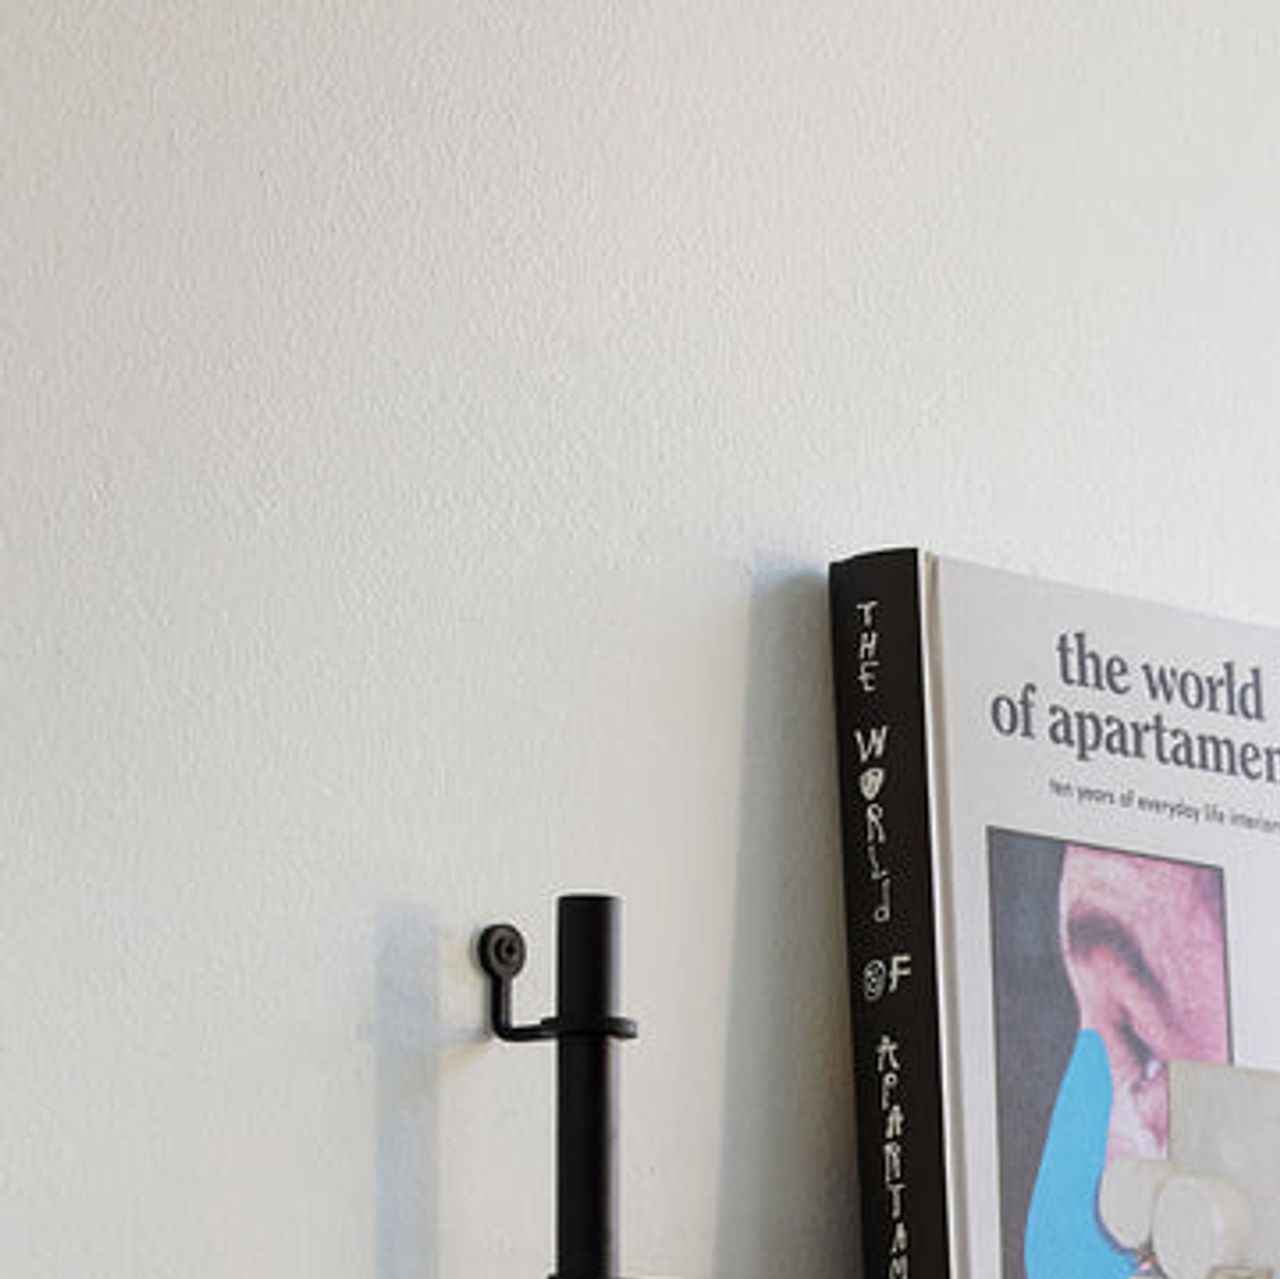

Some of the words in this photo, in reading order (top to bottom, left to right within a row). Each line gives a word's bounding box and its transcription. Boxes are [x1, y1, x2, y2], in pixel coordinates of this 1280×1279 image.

[857, 600, 880, 693] THE
[1056, 631, 1131, 694] the
[1141, 660, 1265, 723] world
[991, 684, 1036, 740] of
[1077, 786, 1114, 805] years
[1120, 789, 1135, 808] of
[1137, 796, 1200, 823] everyday
[1205, 803, 1224, 823] life
